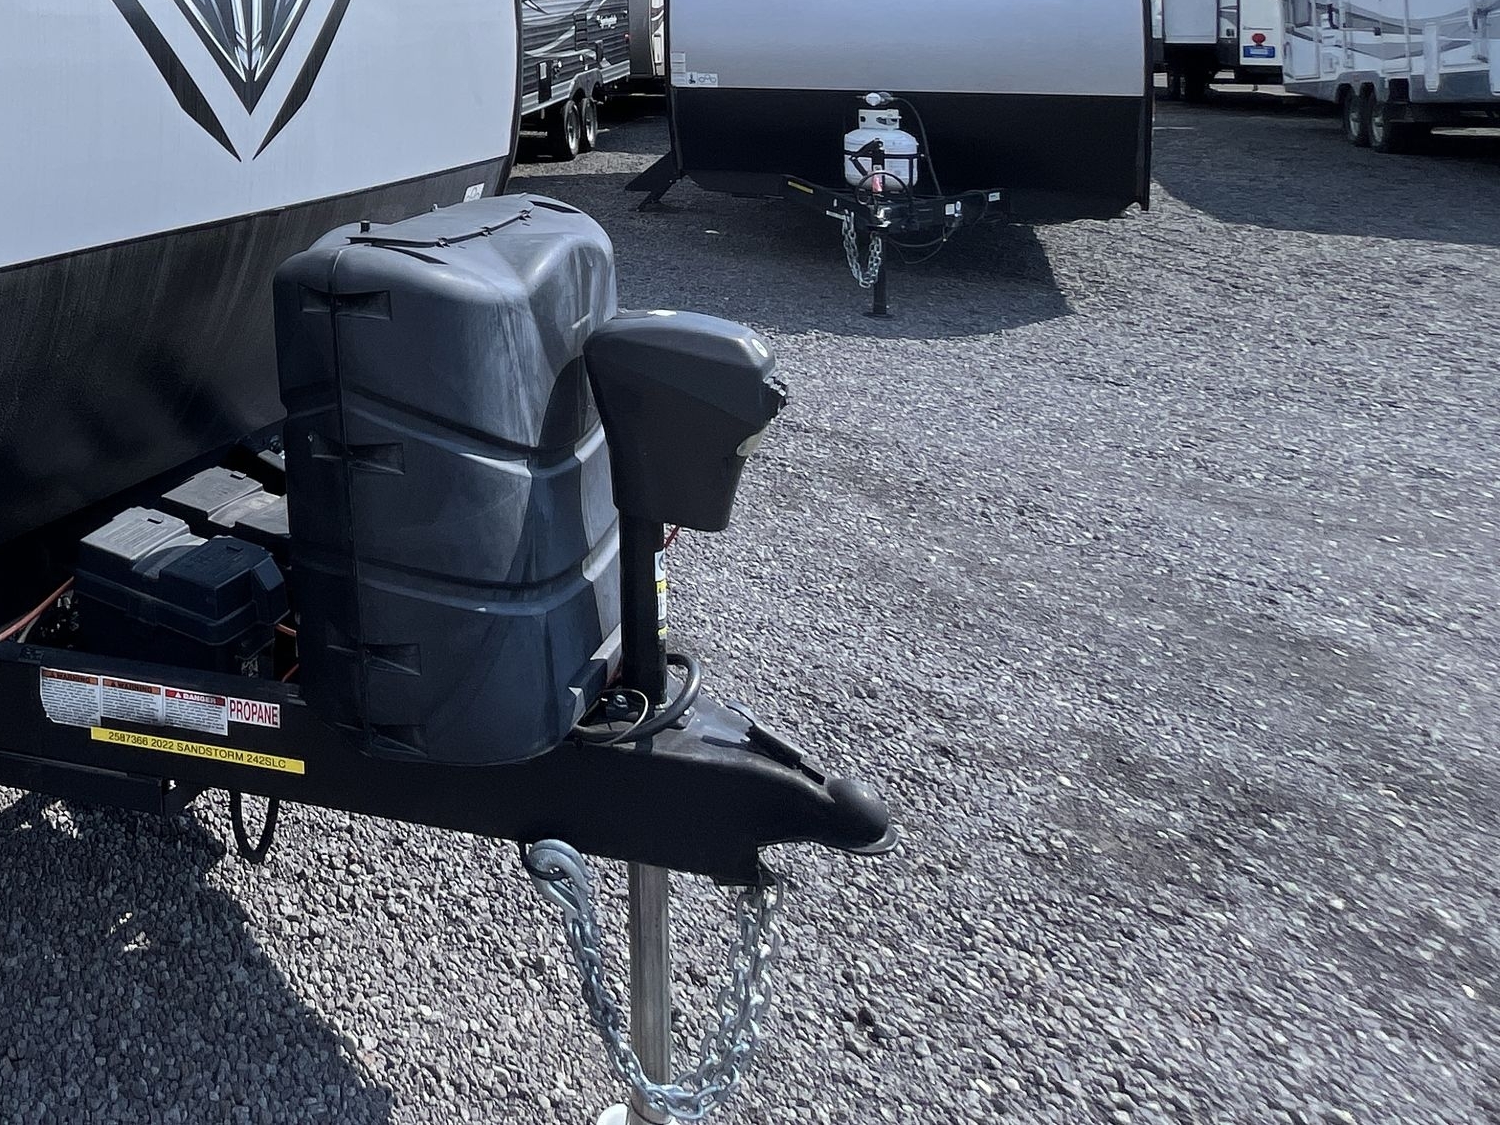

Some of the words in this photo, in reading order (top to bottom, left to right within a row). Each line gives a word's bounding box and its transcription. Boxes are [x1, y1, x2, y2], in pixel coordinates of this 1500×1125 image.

[182, 693, 218, 704] DANGER
[229, 698, 278, 726] PROPANE
[151, 738, 174, 750] 2022
[176, 742, 244, 762] SANDSTORM
[246, 753, 286, 769] 242SLC
